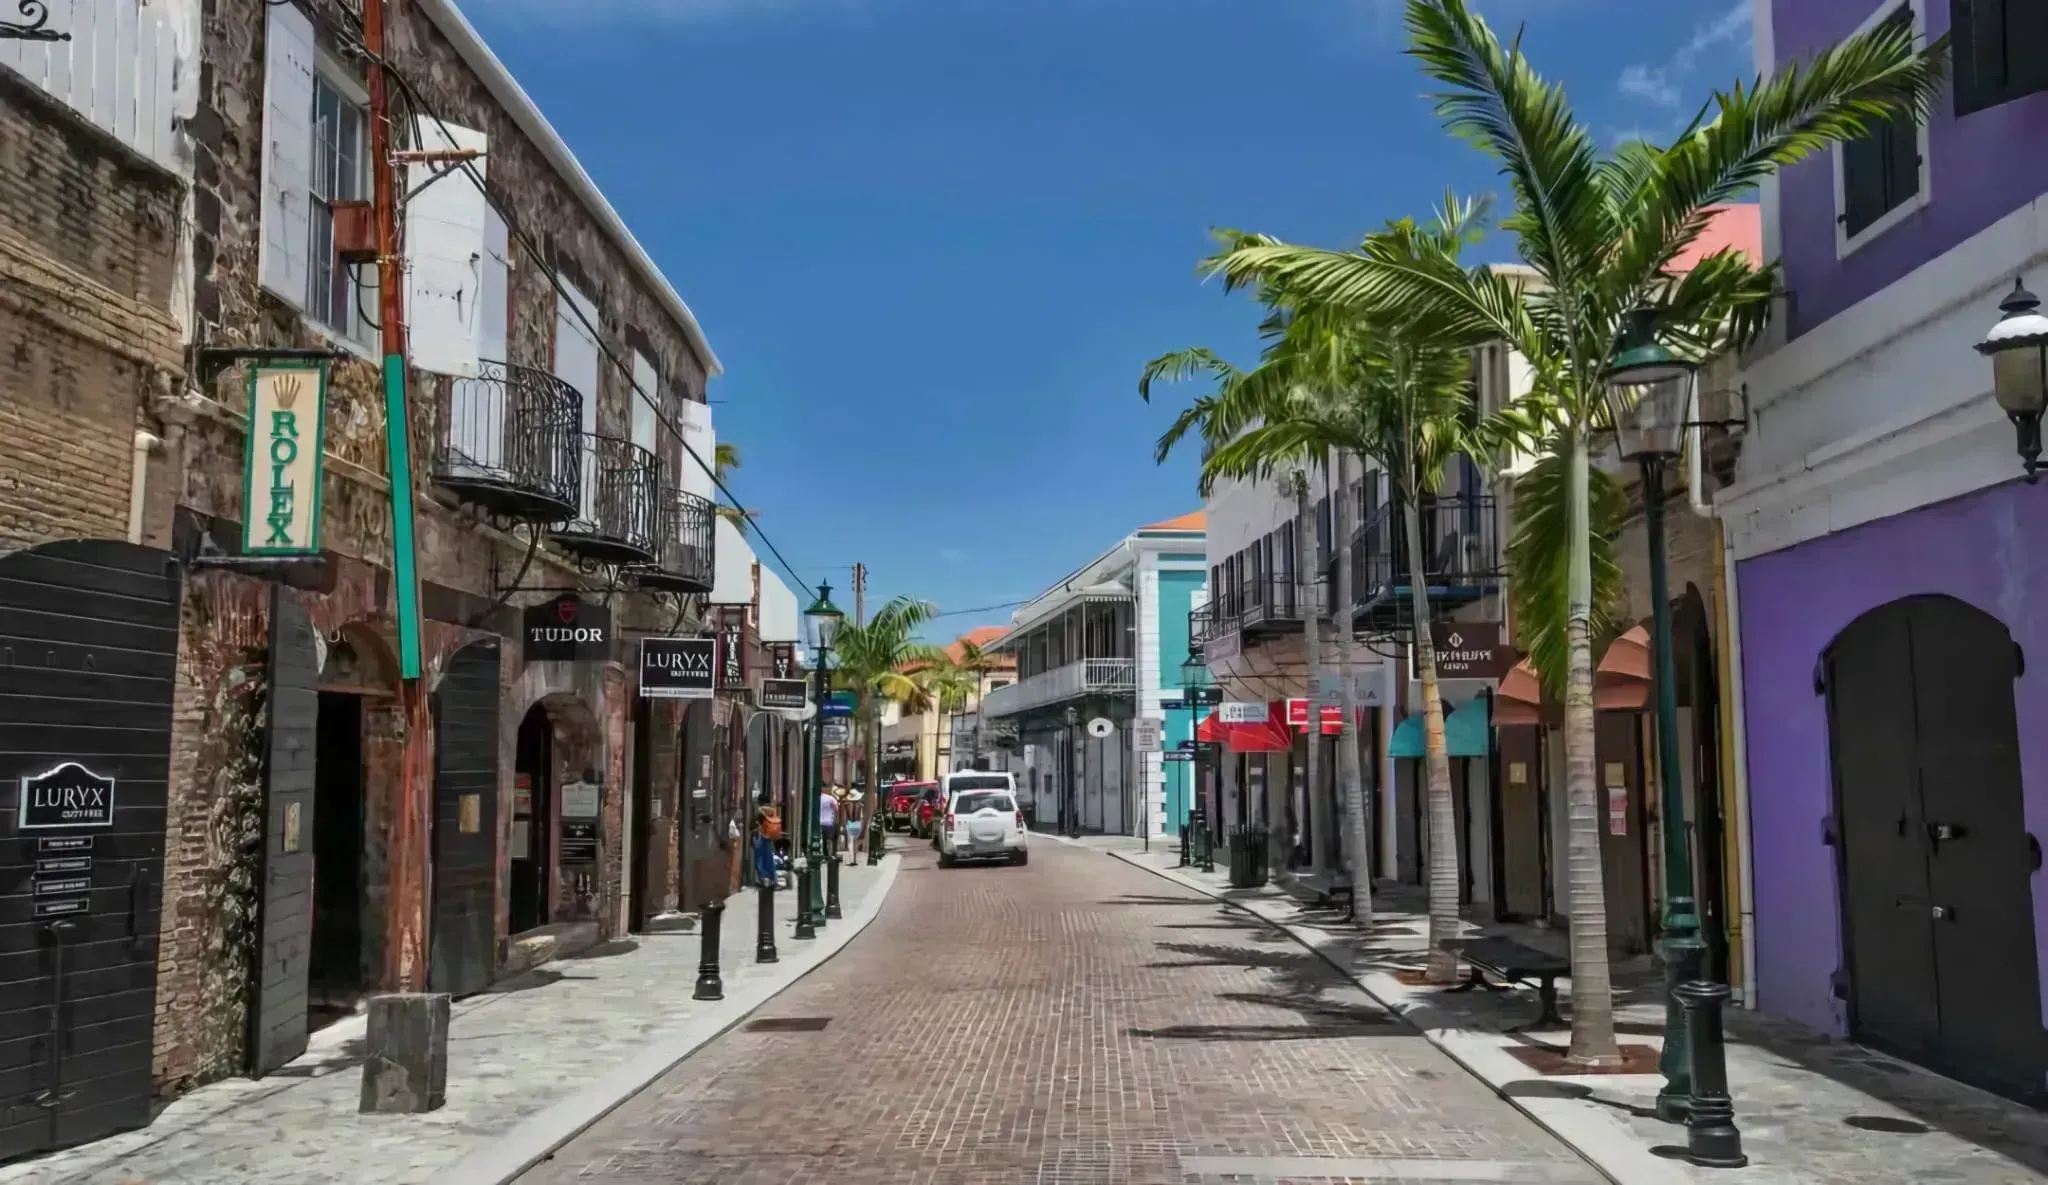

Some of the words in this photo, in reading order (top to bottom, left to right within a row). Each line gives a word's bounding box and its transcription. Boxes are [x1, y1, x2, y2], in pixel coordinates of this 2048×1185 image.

[265, 411, 299, 544] ROLEX
[531, 628, 603, 642] TUDOR
[646, 651, 709, 670] LURYX
[34, 784, 104, 809] LURYX
